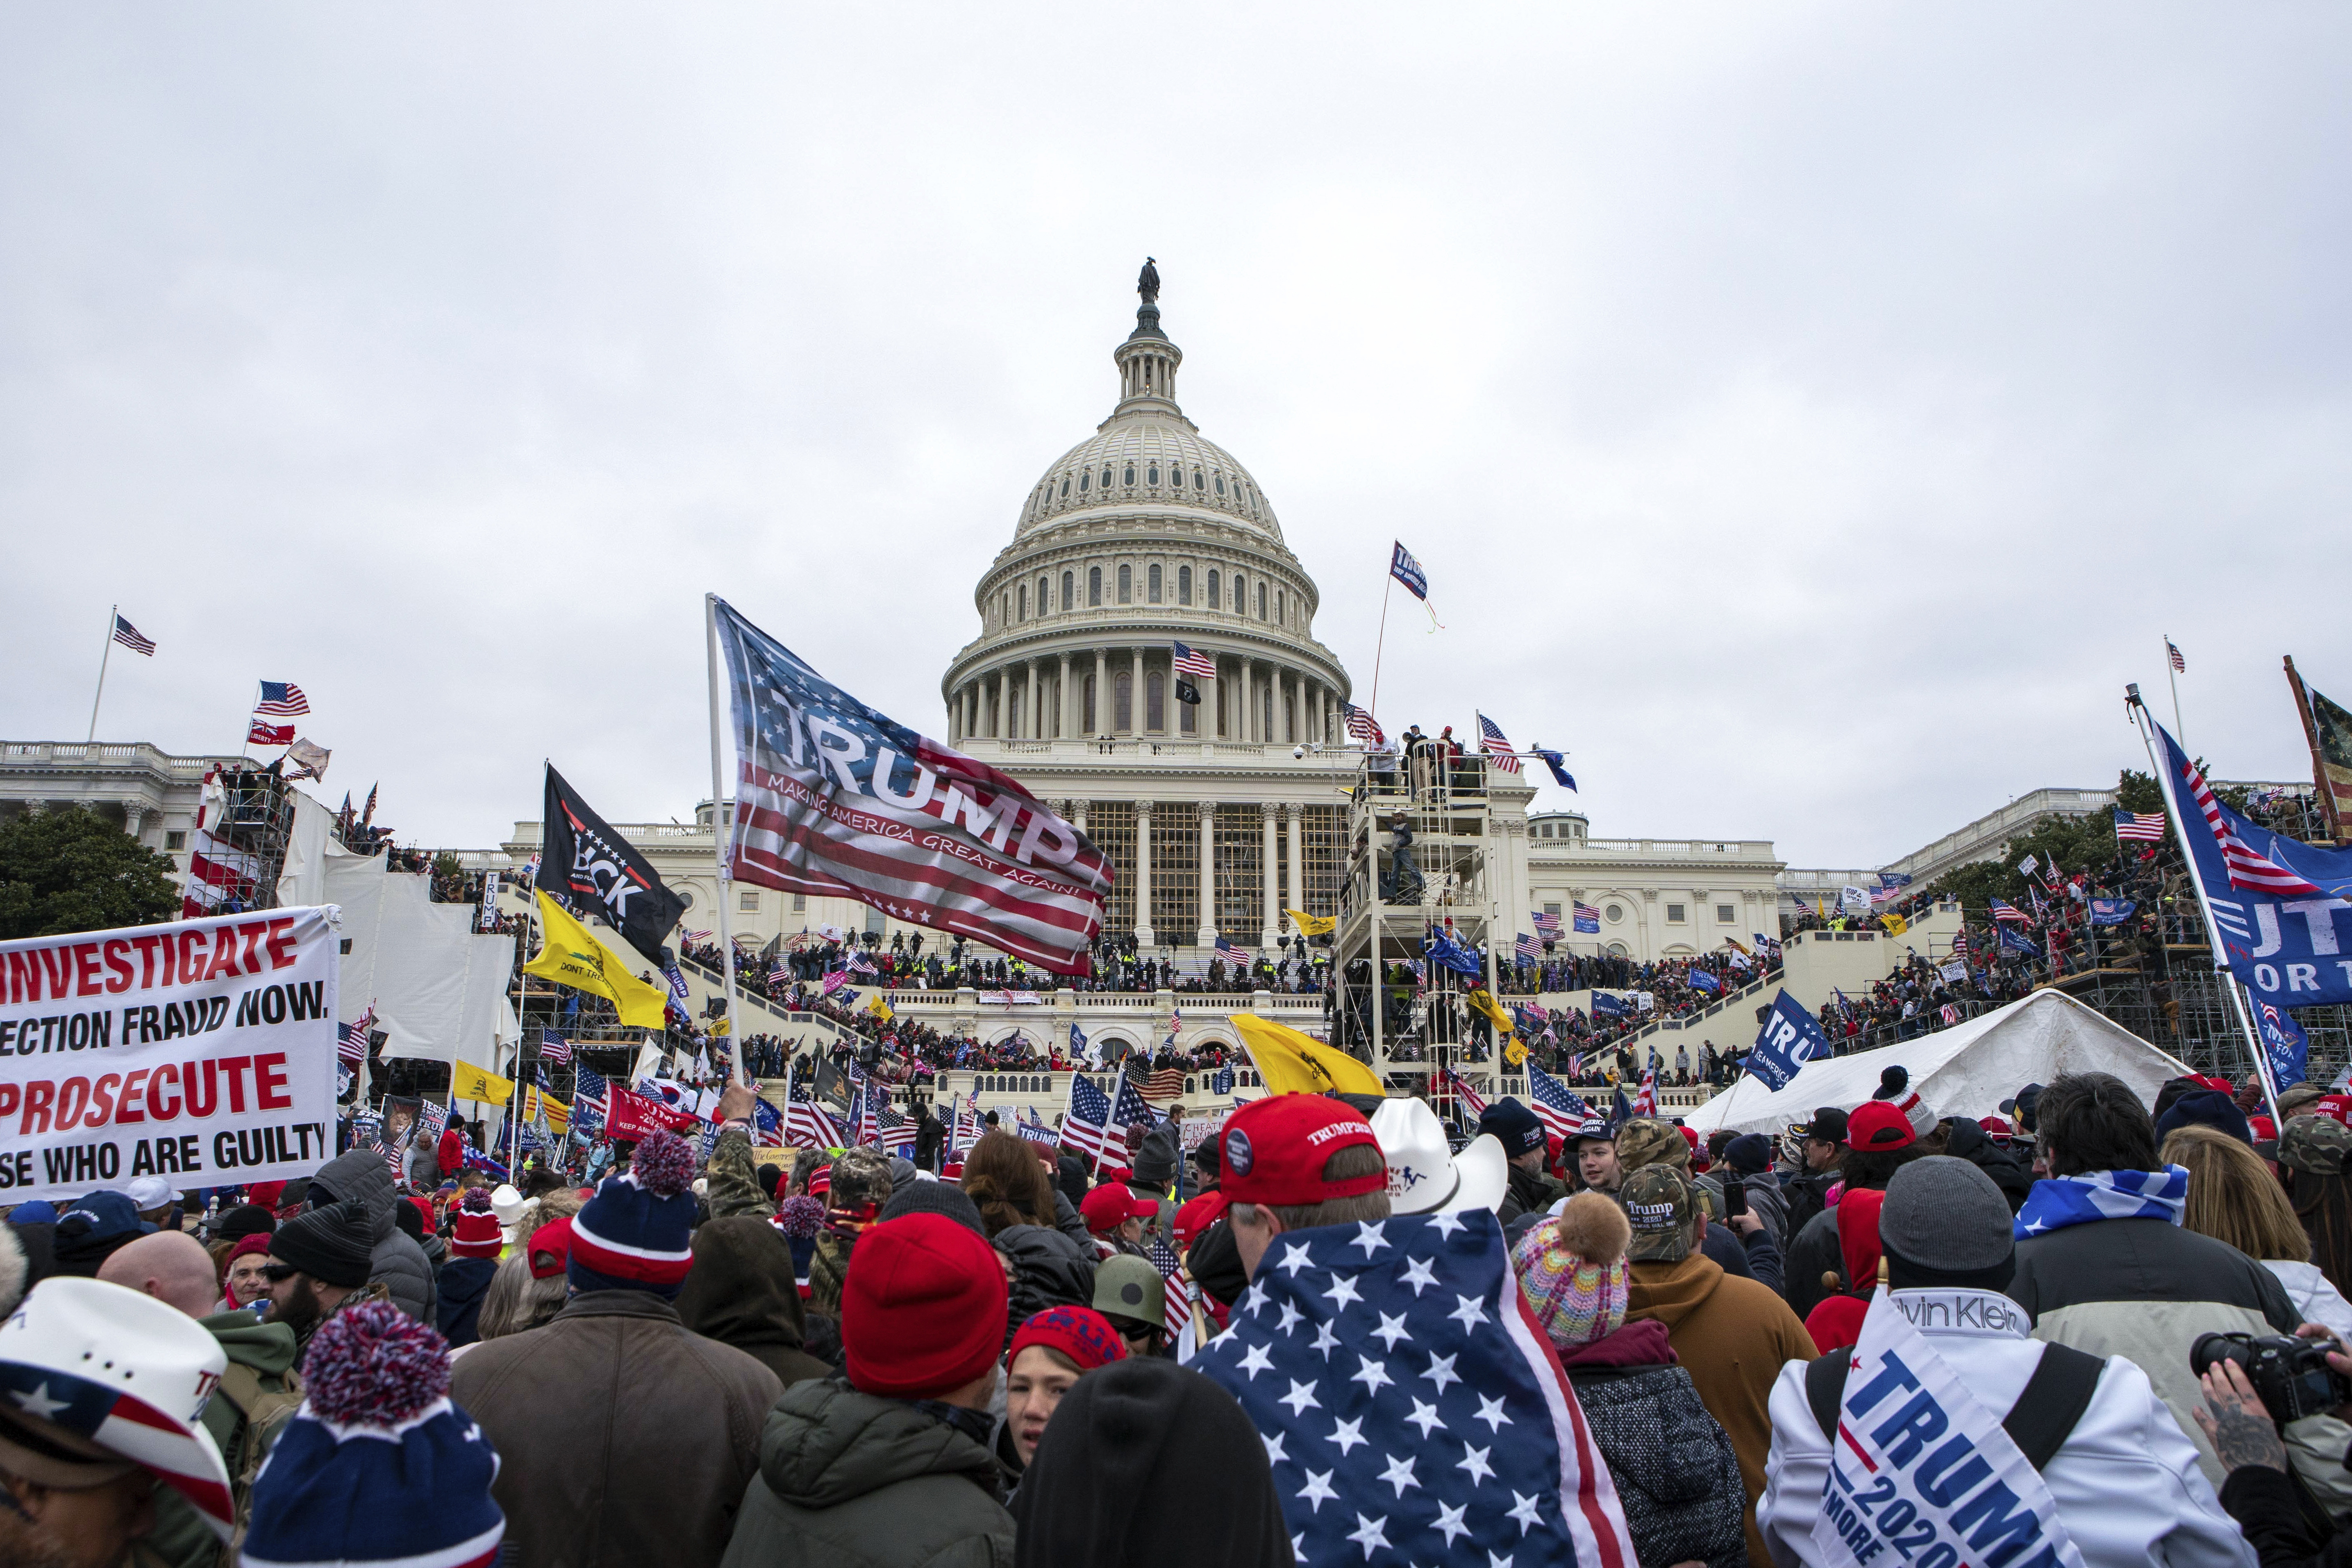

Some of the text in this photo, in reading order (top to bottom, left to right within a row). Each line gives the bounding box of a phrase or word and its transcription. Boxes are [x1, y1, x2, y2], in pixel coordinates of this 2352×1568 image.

[250, 733, 271, 743] LIBERTY
[771, 689, 1078, 865] TRUMP
[768, 774, 1079, 897] MAKING AMERICA GREAT AGAIN!
[584, 875, 595, 883] FUC
[482, 874, 497, 926] TRUMP
[0, 917, 298, 1004] INVESTIGATE
[561, 962, 584, 975] DONT
[1942, 962, 1965, 973] DEFUND
[670, 966, 687, 996] TRUMP
[1694, 971, 1718, 984] TRUMP
[2254, 963, 2321, 993] OR
[122, 996, 230, 1045] FRAUD
[236, 980, 328, 1027] NOW.
[1595, 1004, 1620, 1015] LIBERTY
[1765, 1009, 1815, 1068] TRU
[1761, 1057, 1790, 1083] AMERICA
[0, 1052, 292, 1135] PROSECUTE
[619, 1088, 680, 1124] TRUM
[619, 1122, 636, 1130] KEEP
[1020, 1127, 1058, 1146] TRUMP
[1185, 1122, 1225, 1132] CHEATI
[1193, 1130, 1219, 1138] LYIN
[1523, 1127, 1541, 1139] Trump
[44, 1142, 120, 1184] WHO
[132, 1134, 202, 1176] ARE
[214, 1122, 325, 1168] GUILTY
[753, 1150, 766, 1161] The
[81, 1210, 100, 1223] TRUMP
[1627, 1201, 1673, 1217] Trump
[1897, 1296, 2017, 1332] lvin Klein
[1845, 1348, 2066, 1568] TRUM
[1823, 1490, 1884, 1566] MORE
